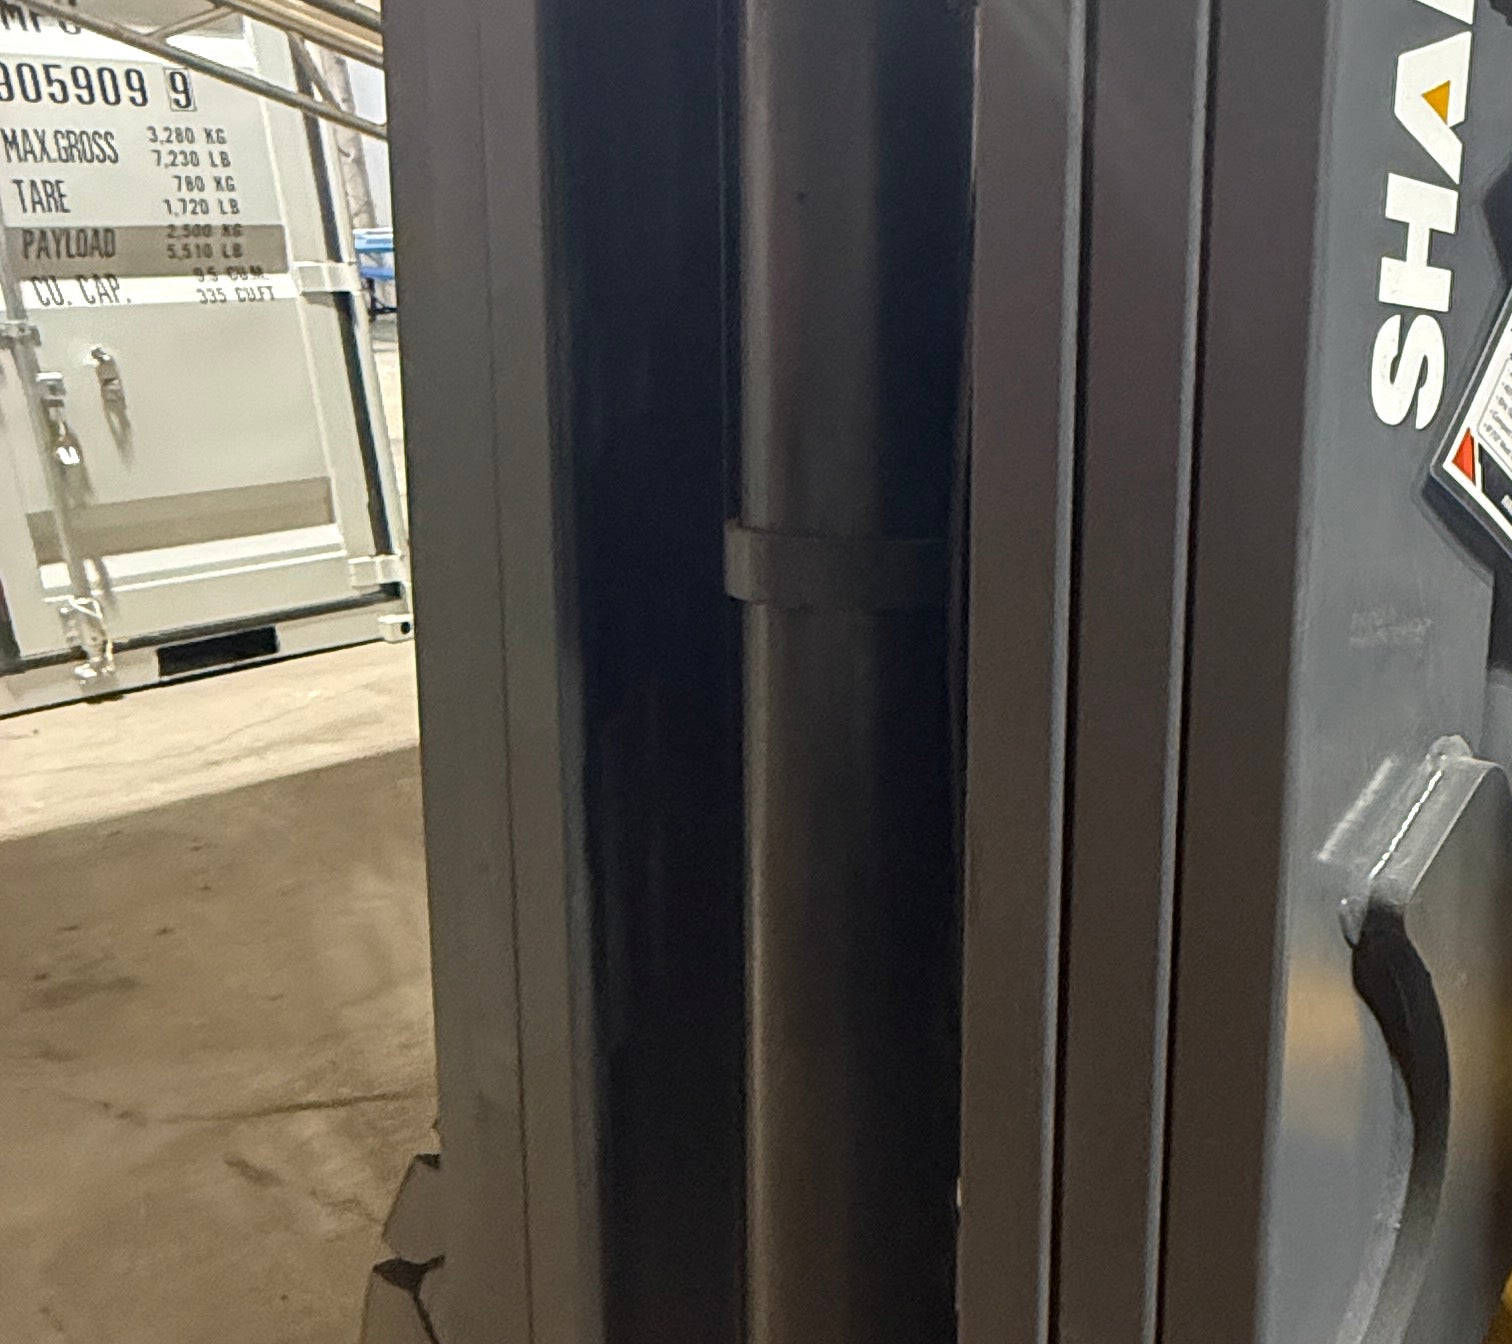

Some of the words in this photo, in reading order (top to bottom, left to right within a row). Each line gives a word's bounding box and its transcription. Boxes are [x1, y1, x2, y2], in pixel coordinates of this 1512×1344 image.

[169, 70, 193, 109] 9
[204, 128, 227, 144] KG
[209, 150, 231, 168] LB
[12, 179, 71, 213] TARE
[173, 175, 206, 192] 780
[214, 177, 236, 192] KG
[218, 199, 241, 215] LB
[22, 228, 116, 259] PAYLOAD
[222, 244, 244, 259] LB
[196, 288, 228, 305] 335
